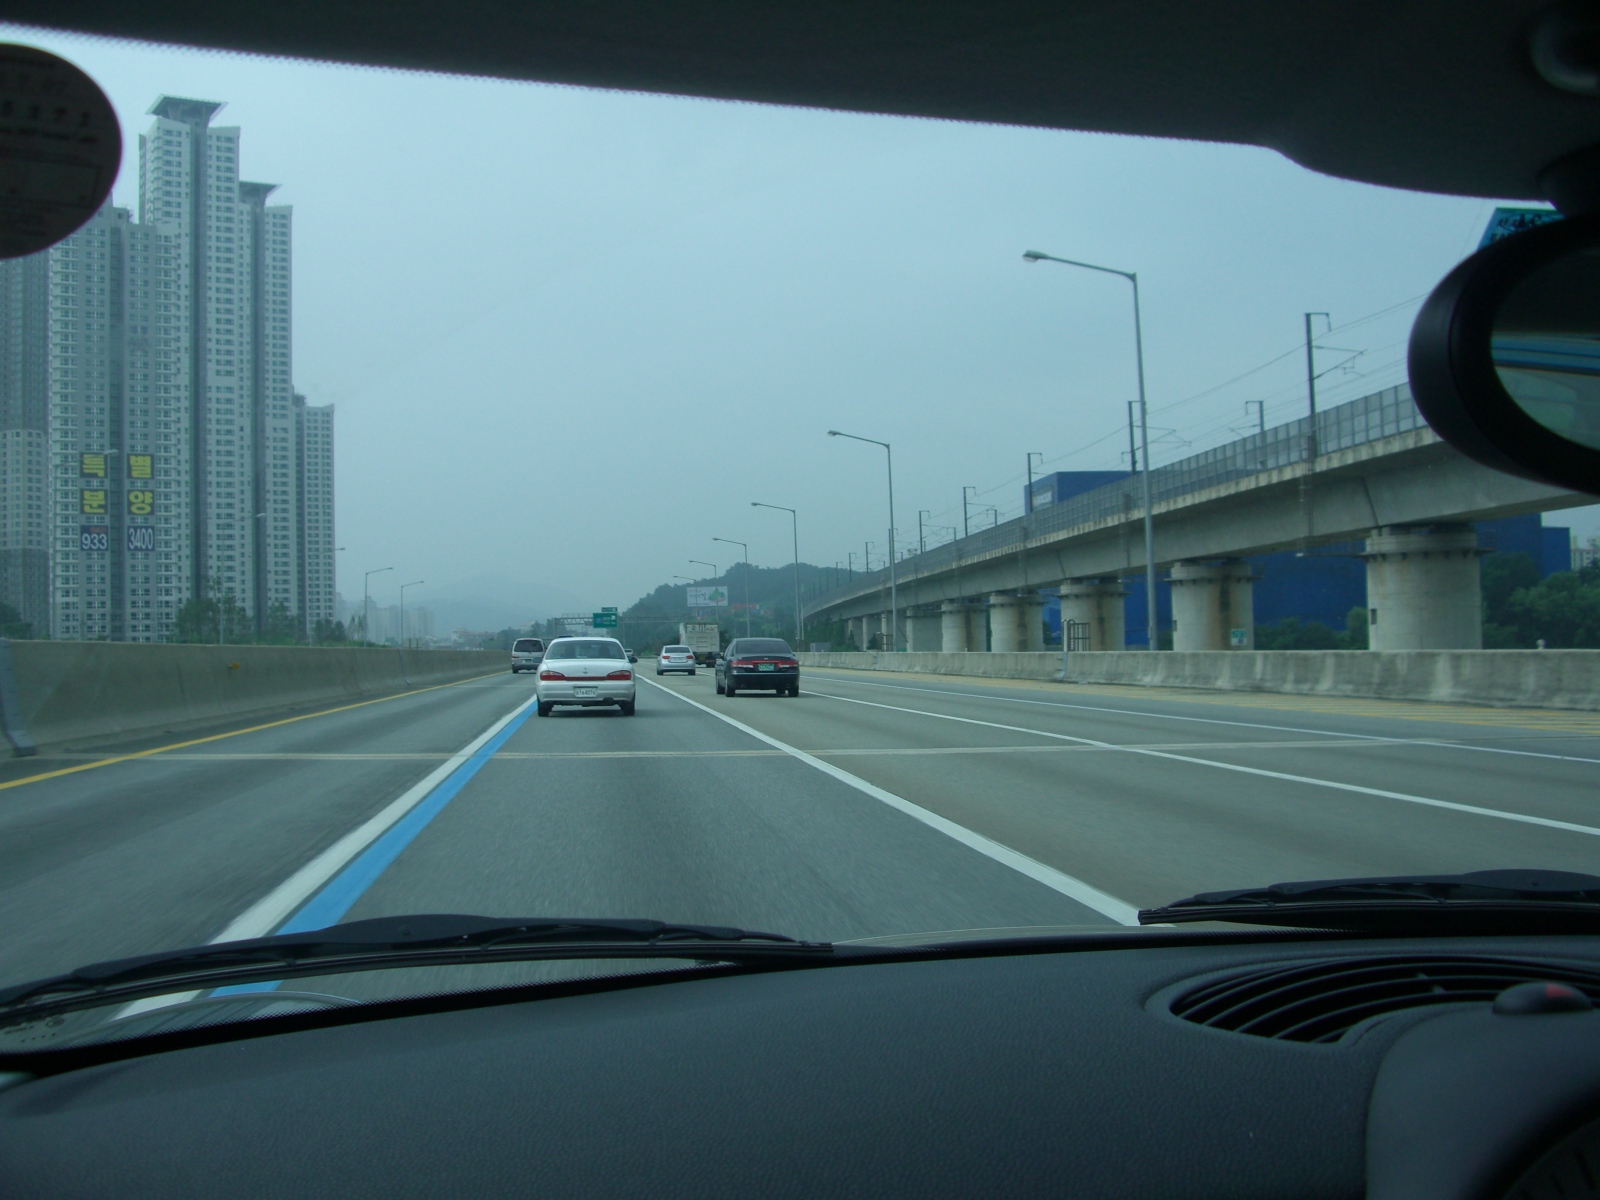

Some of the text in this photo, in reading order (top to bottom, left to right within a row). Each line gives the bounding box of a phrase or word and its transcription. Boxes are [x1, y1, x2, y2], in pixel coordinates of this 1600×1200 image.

[83, 454, 152, 478] 특 별
[83, 490, 153, 514] 분 양
[82, 527, 154, 550] 933 3400
